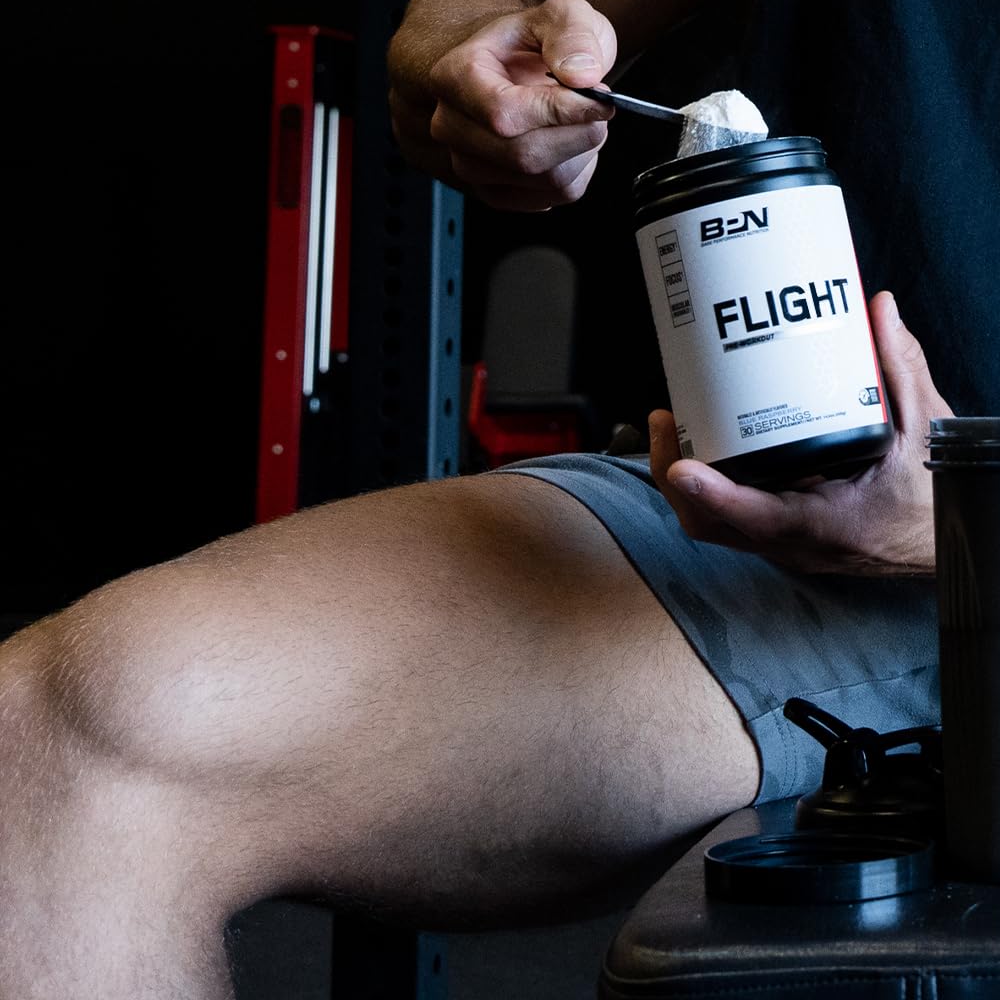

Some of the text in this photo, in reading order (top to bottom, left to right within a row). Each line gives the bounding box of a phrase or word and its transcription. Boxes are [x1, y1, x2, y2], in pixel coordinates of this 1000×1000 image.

[700, 207, 768, 241] BPN
[713, 278, 849, 339] FLIGHT
[741, 426, 753, 437] 30
[754, 411, 812, 430] SERVINGS
[758, 407, 802, 421] RASPBERRY
